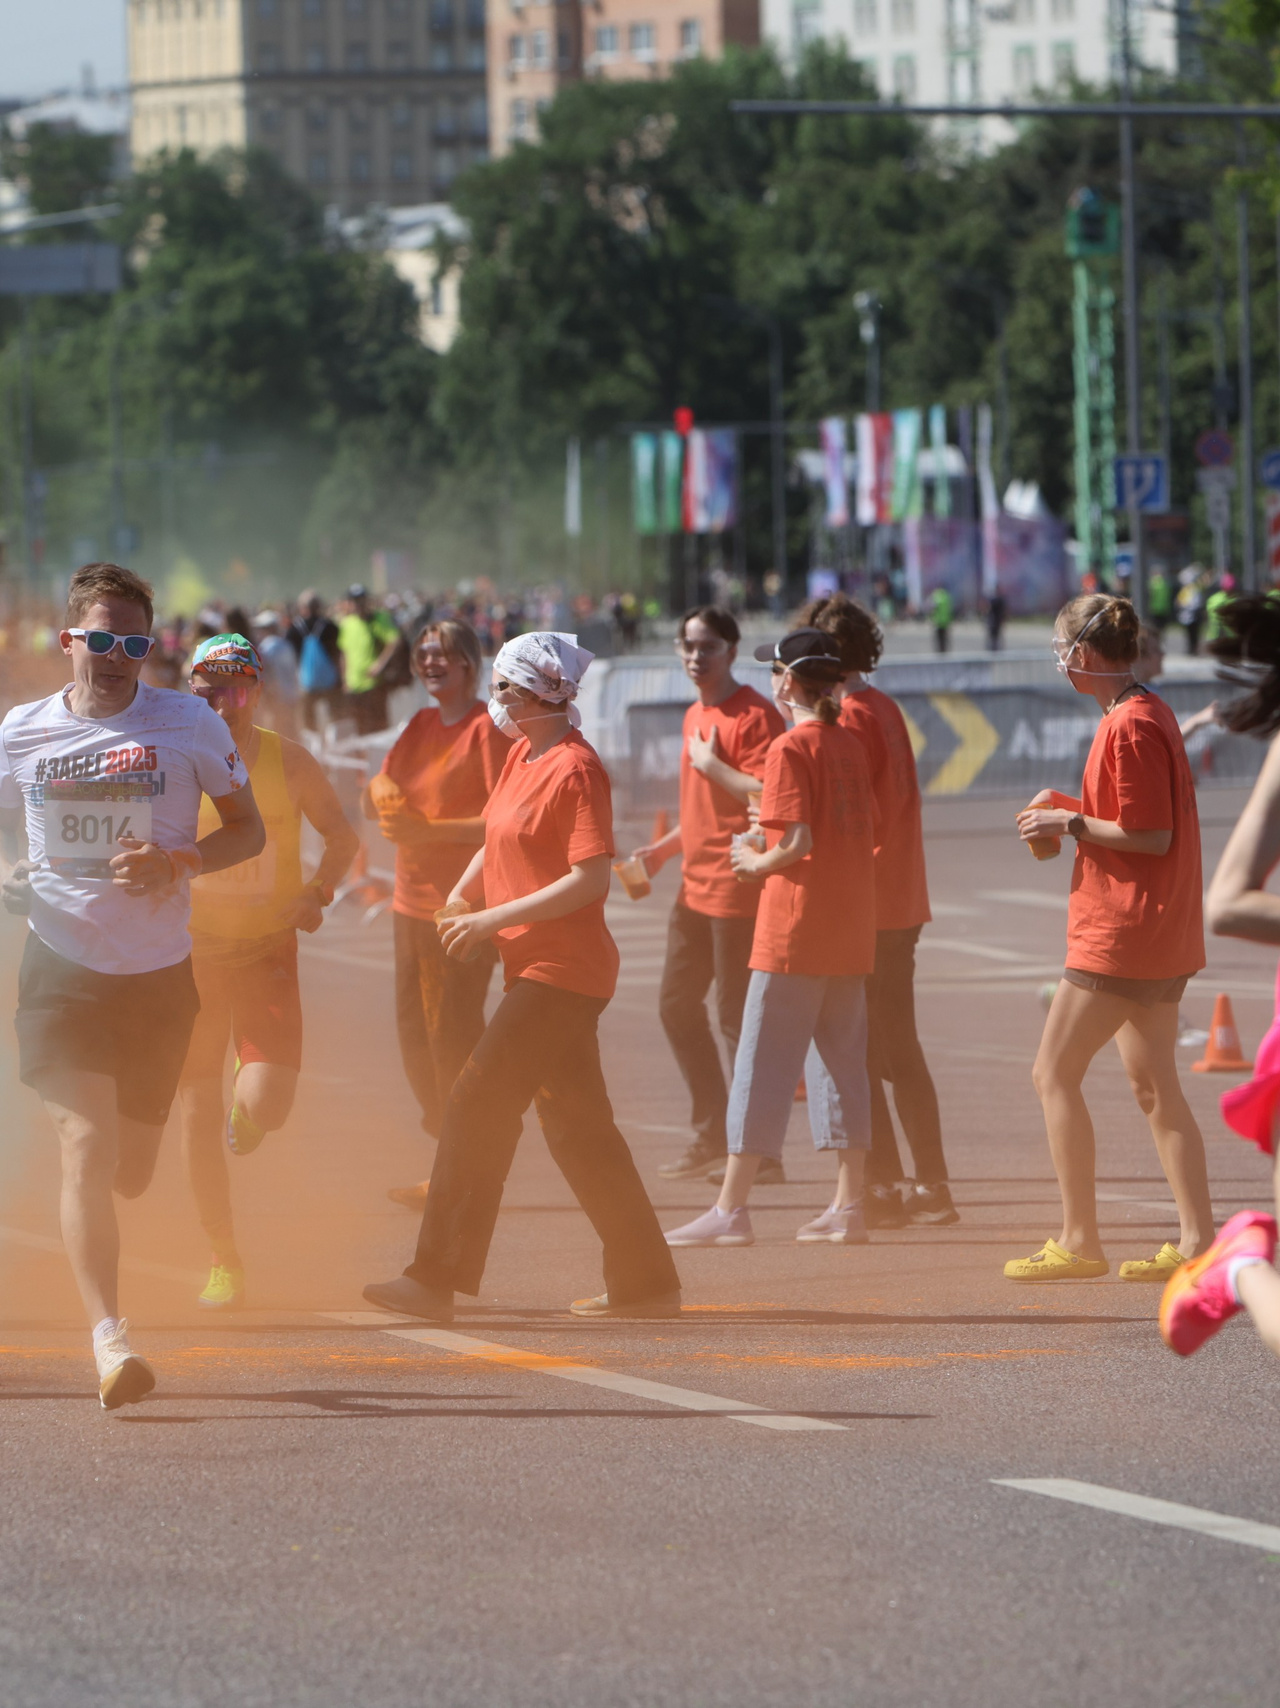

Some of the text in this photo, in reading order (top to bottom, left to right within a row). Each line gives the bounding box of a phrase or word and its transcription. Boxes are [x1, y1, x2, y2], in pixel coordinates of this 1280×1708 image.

[203, 664, 244, 674] WTF!
[34, 746, 158, 783] #ЗАБЕГ2025
[60, 814, 135, 845] 8014
